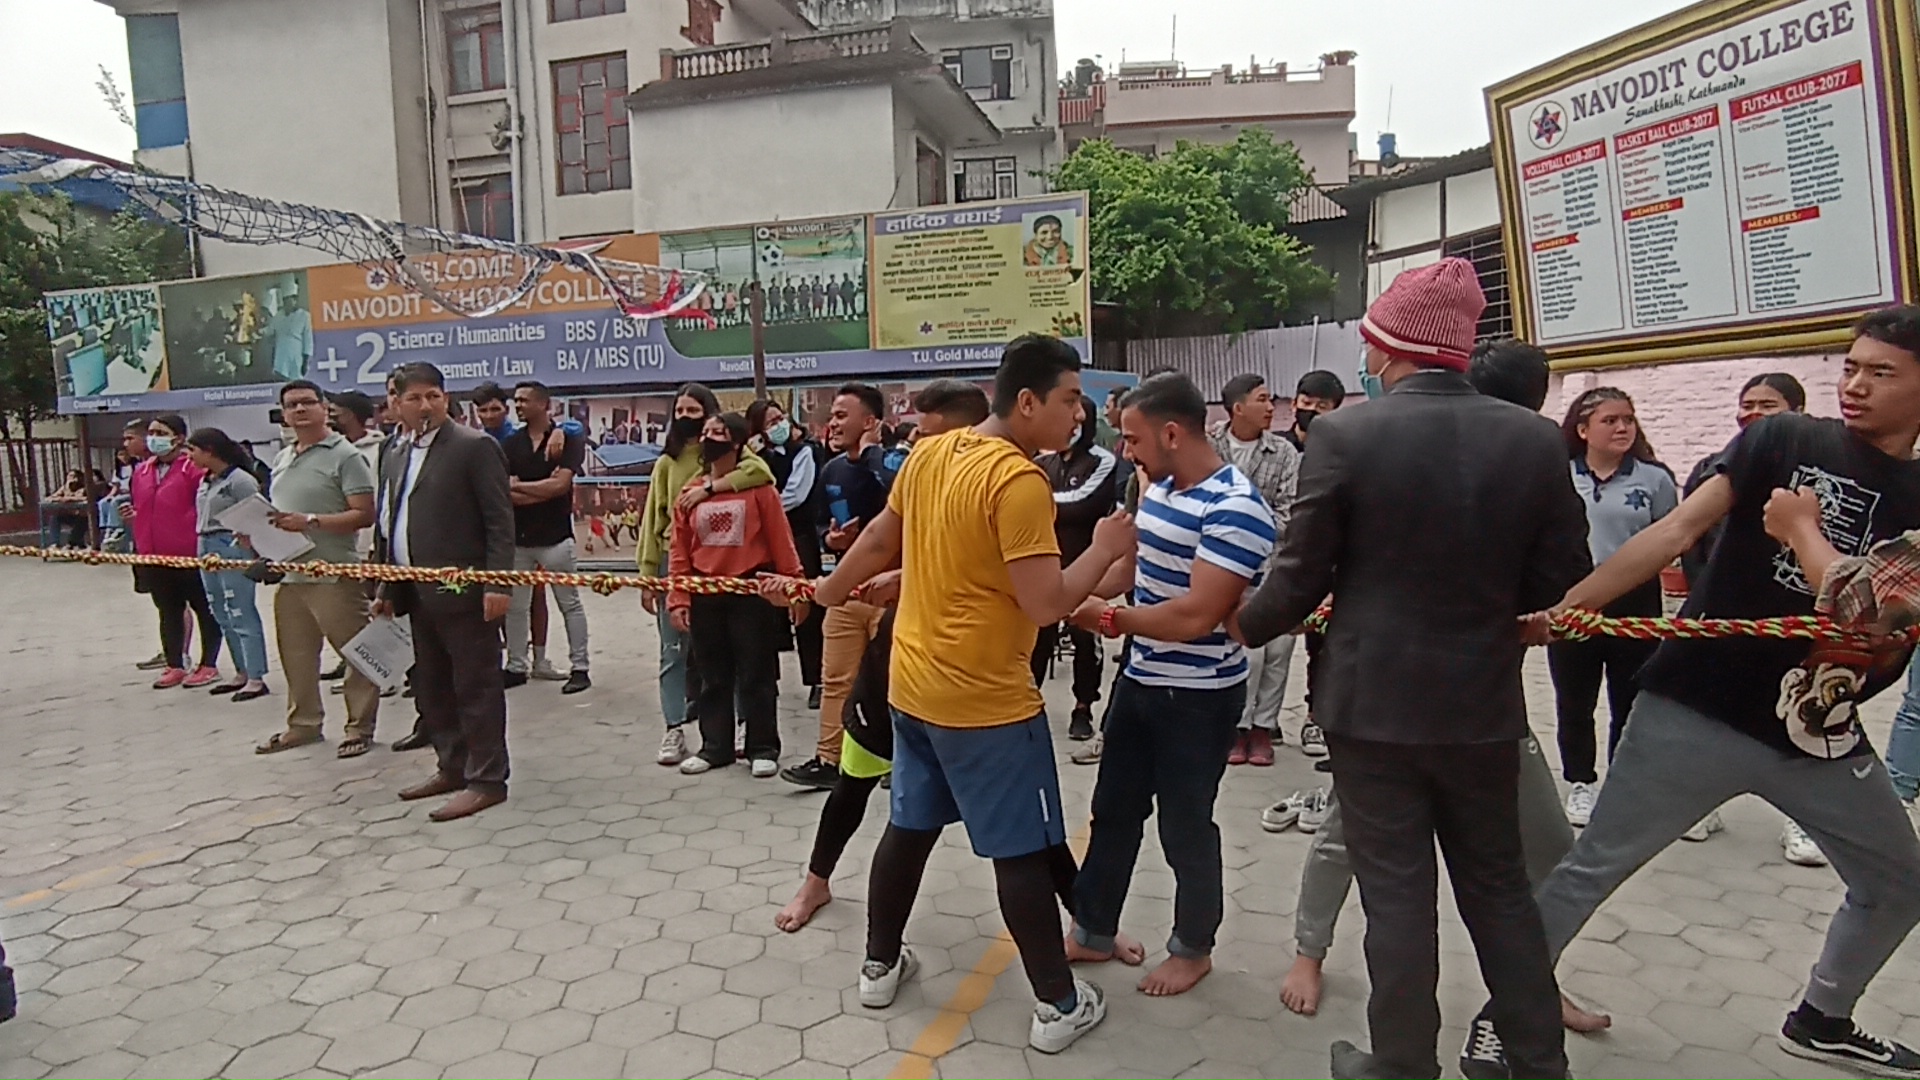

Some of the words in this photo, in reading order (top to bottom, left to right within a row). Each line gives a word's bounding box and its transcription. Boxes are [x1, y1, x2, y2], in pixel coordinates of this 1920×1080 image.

[1571, 57, 1687, 121] NAVODIT
[1697, 1, 1854, 78] COLLEGE
[1688, 76, 1746, 102] Kathmandu
[1741, 90, 1783, 114] FUTSAL
[1785, 70, 1848, 100] CLUB-2077
[1618, 131, 1647, 150] BASKET
[1648, 126, 1668, 140] BALL
[1669, 111, 1713, 135] CLUB-2077
[1525, 155, 1564, 177] VOLLEYBALL
[1564, 144, 1600, 164] CLUB-2077
[885, 210, 948, 233] हार्दिक
[953, 207, 1003, 226] बधाई
[322, 293, 422, 322] NAVODIT
[388, 330, 444, 350] Science
[457, 321, 545, 346] Humanities
[565, 320, 596, 342] BBS
[613, 317, 649, 339] BSW
[503, 356, 534, 376] Law
[556, 349, 579, 370] BA
[595, 345, 629, 368] MBS
[633, 344, 665, 370] (TU)
[912, 351, 933, 363] T.U.
[935, 348, 961, 362] Gold
[203, 390, 224, 401] Hotel
[354, 645, 390, 678] NAVODIT
